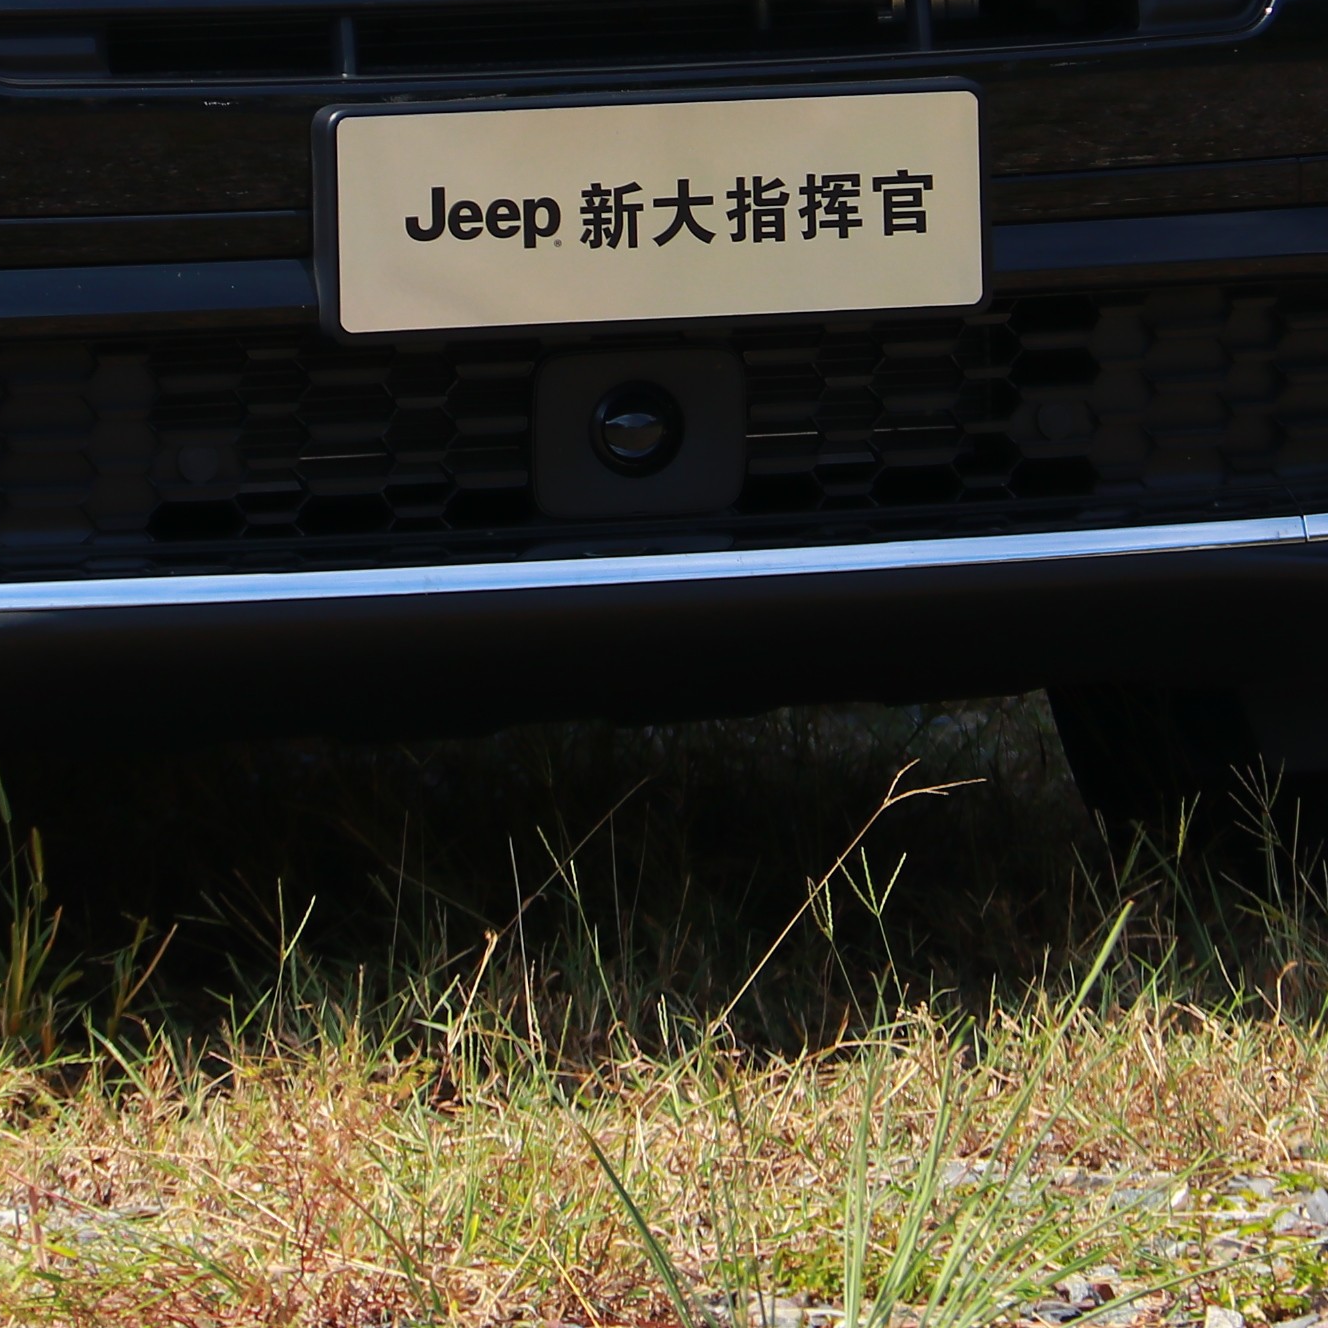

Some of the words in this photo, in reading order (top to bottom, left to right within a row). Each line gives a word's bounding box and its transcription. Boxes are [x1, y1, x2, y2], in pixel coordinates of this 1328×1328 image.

[405, 186, 562, 250] Jeep
[579, 169, 935, 250] 新大指挥官
